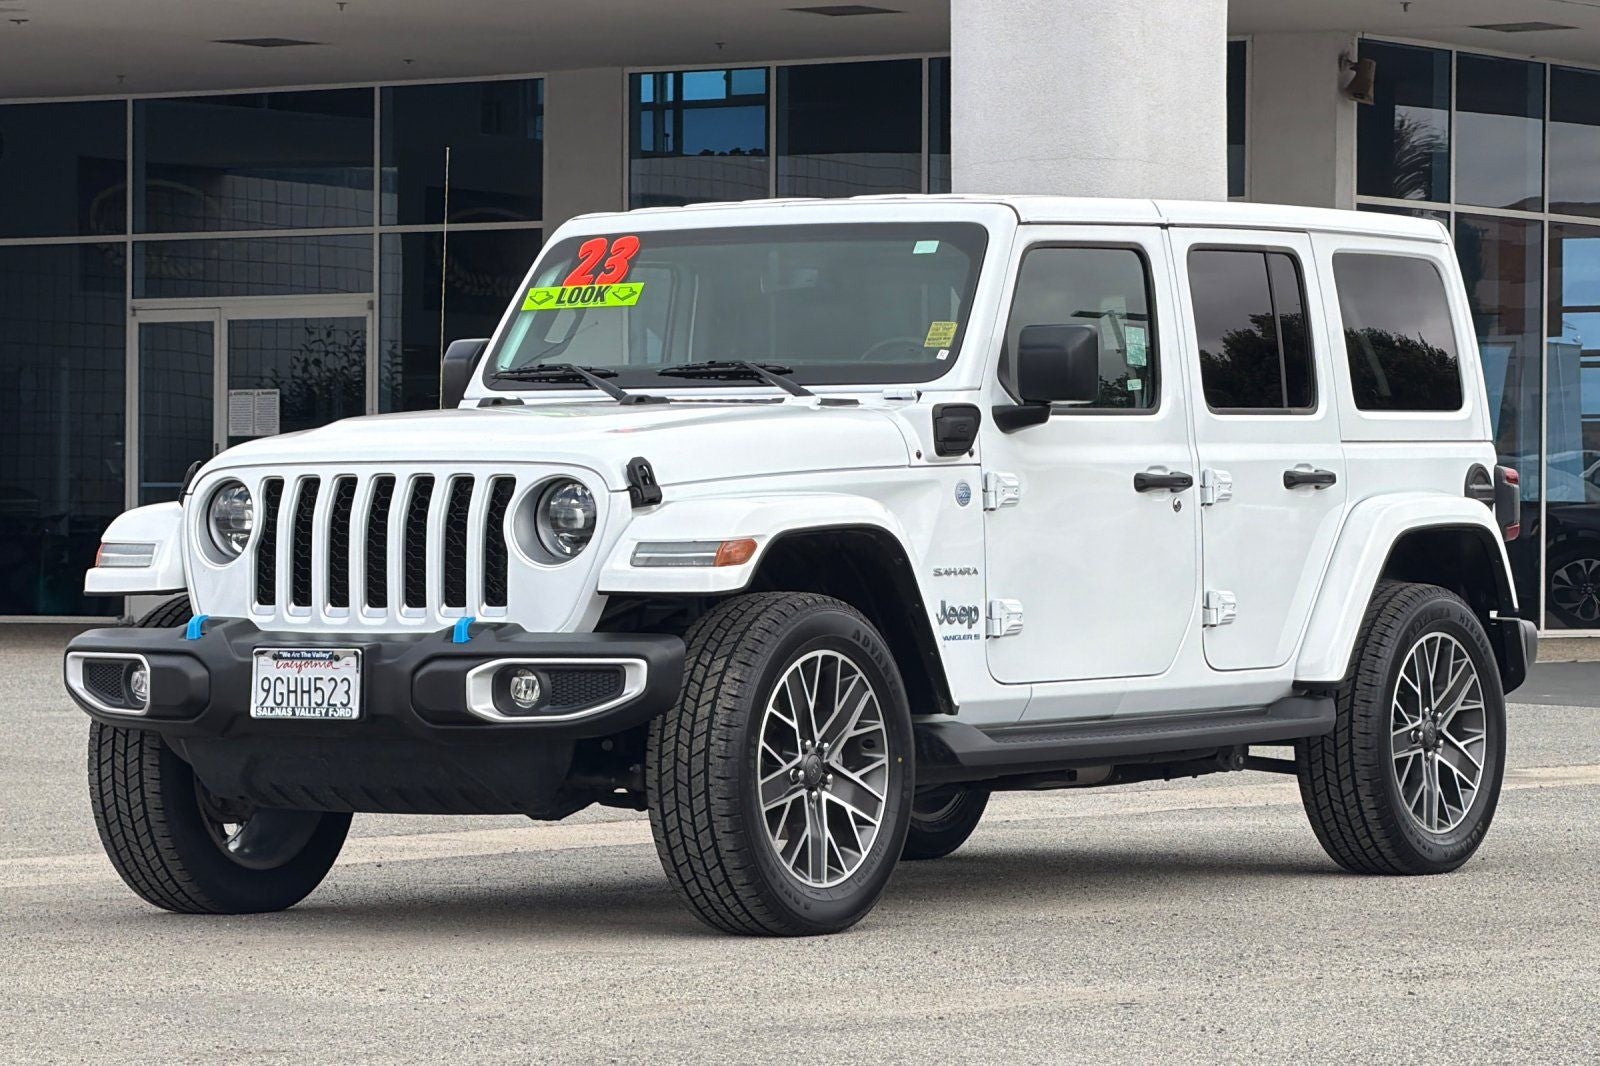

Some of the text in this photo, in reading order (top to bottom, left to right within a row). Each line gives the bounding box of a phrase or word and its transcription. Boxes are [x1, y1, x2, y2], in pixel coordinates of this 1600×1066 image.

[562, 235, 640, 287] 23
[555, 286, 611, 306] LOOK
[933, 567, 978, 577] SAHARA
[936, 599, 980, 629] Jeep
[311, 651, 333, 660] Valley"
[275, 660, 340, 674] California
[260, 676, 352, 707] 9GHH523
[294, 707, 328, 717] VALLEY
